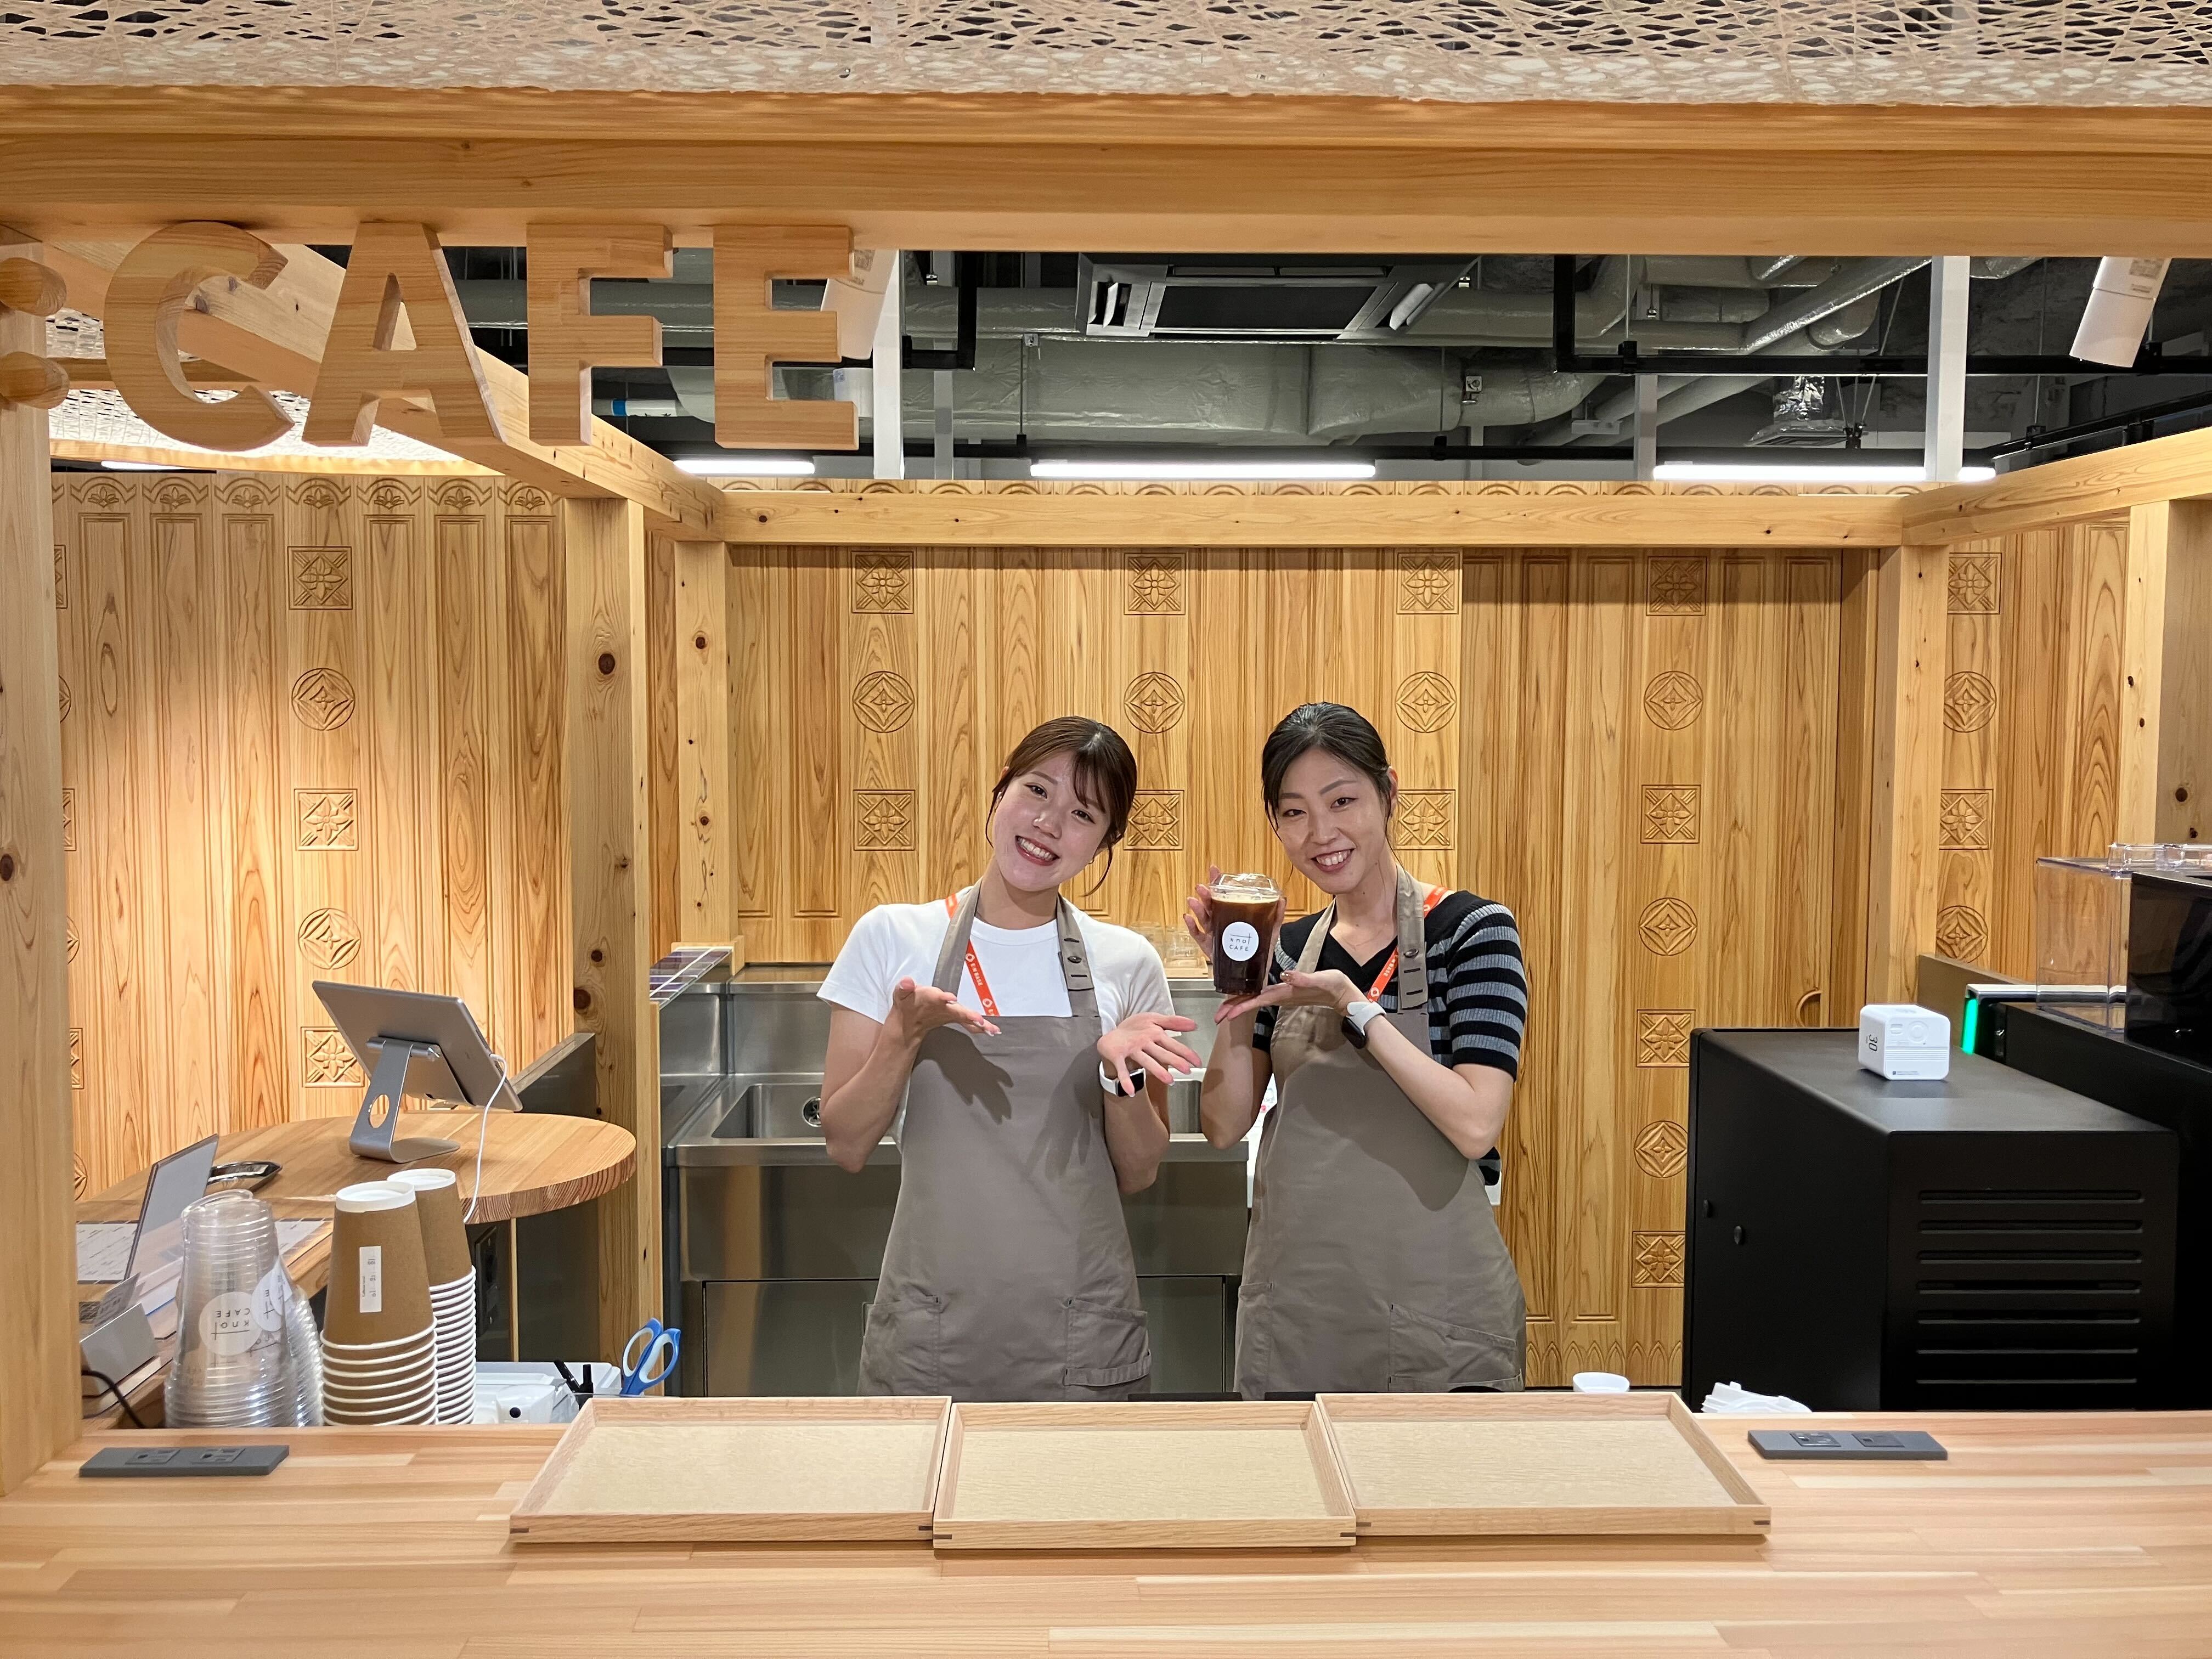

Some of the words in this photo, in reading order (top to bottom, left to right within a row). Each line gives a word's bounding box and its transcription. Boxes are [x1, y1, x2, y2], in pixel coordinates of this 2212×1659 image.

[104, 221, 860, 452] CAFE
[1229, 933, 1252, 944] knot
[1869, 1034, 1878, 1052] 30
[215, 1308, 250, 1318] CAFE
[211, 1319, 250, 1340] knot
